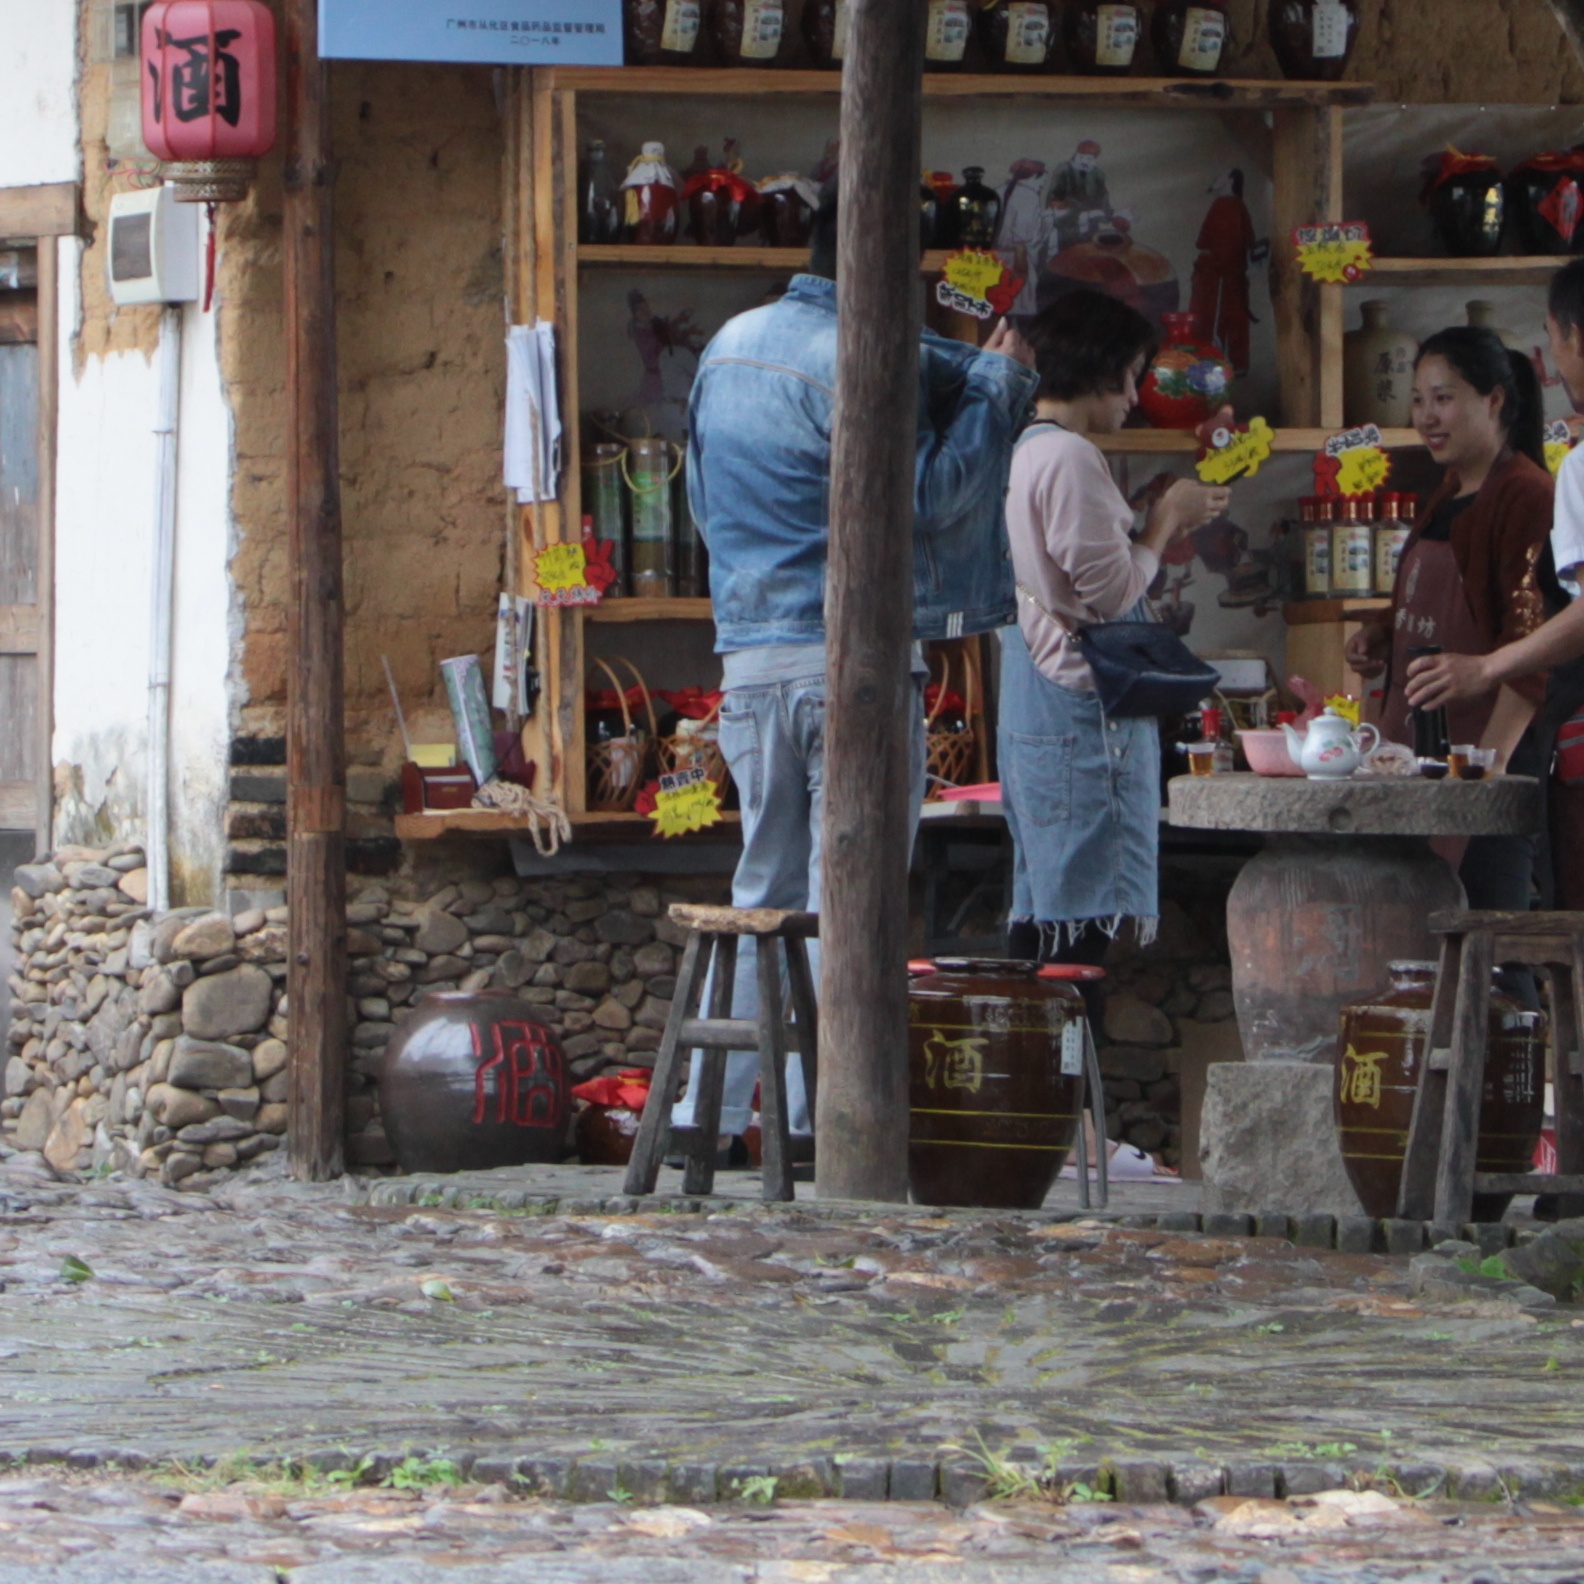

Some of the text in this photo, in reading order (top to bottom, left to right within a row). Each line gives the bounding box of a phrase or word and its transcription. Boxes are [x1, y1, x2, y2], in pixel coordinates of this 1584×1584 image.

[148, 27, 241, 127] 酒
[923, 1029, 989, 1094] 酒
[1340, 1043, 1389, 1109] 酒
